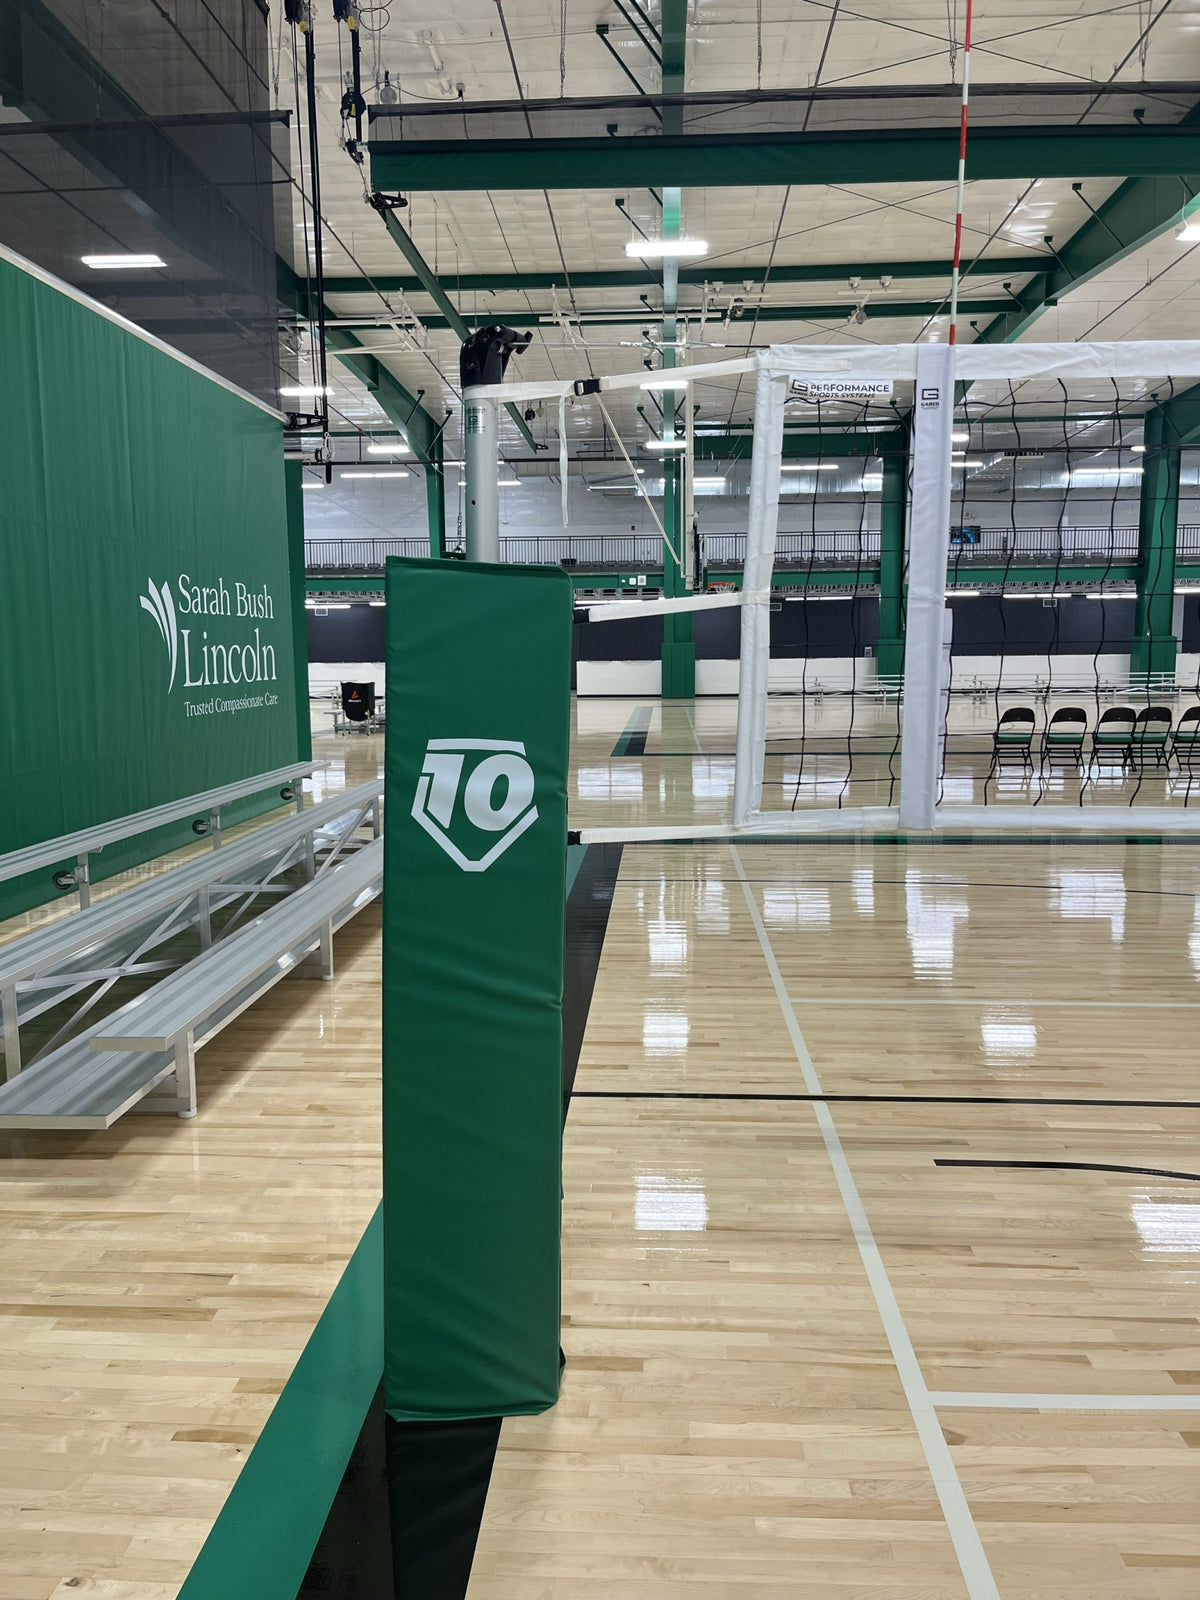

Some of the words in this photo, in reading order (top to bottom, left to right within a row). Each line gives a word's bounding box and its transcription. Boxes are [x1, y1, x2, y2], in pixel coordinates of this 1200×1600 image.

[809, 390, 839, 399] SPORTS
[810, 384, 890, 393] PERFORMANCE
[178, 574, 231, 616] Sarah
[234, 582, 274, 619] Bush
[181, 627, 278, 688] Lincoln
[184, 697, 214, 717] Trusted
[215, 694, 264, 715] Compassionate
[264, 692, 279, 706] Care
[421, 752, 535, 832] 10
